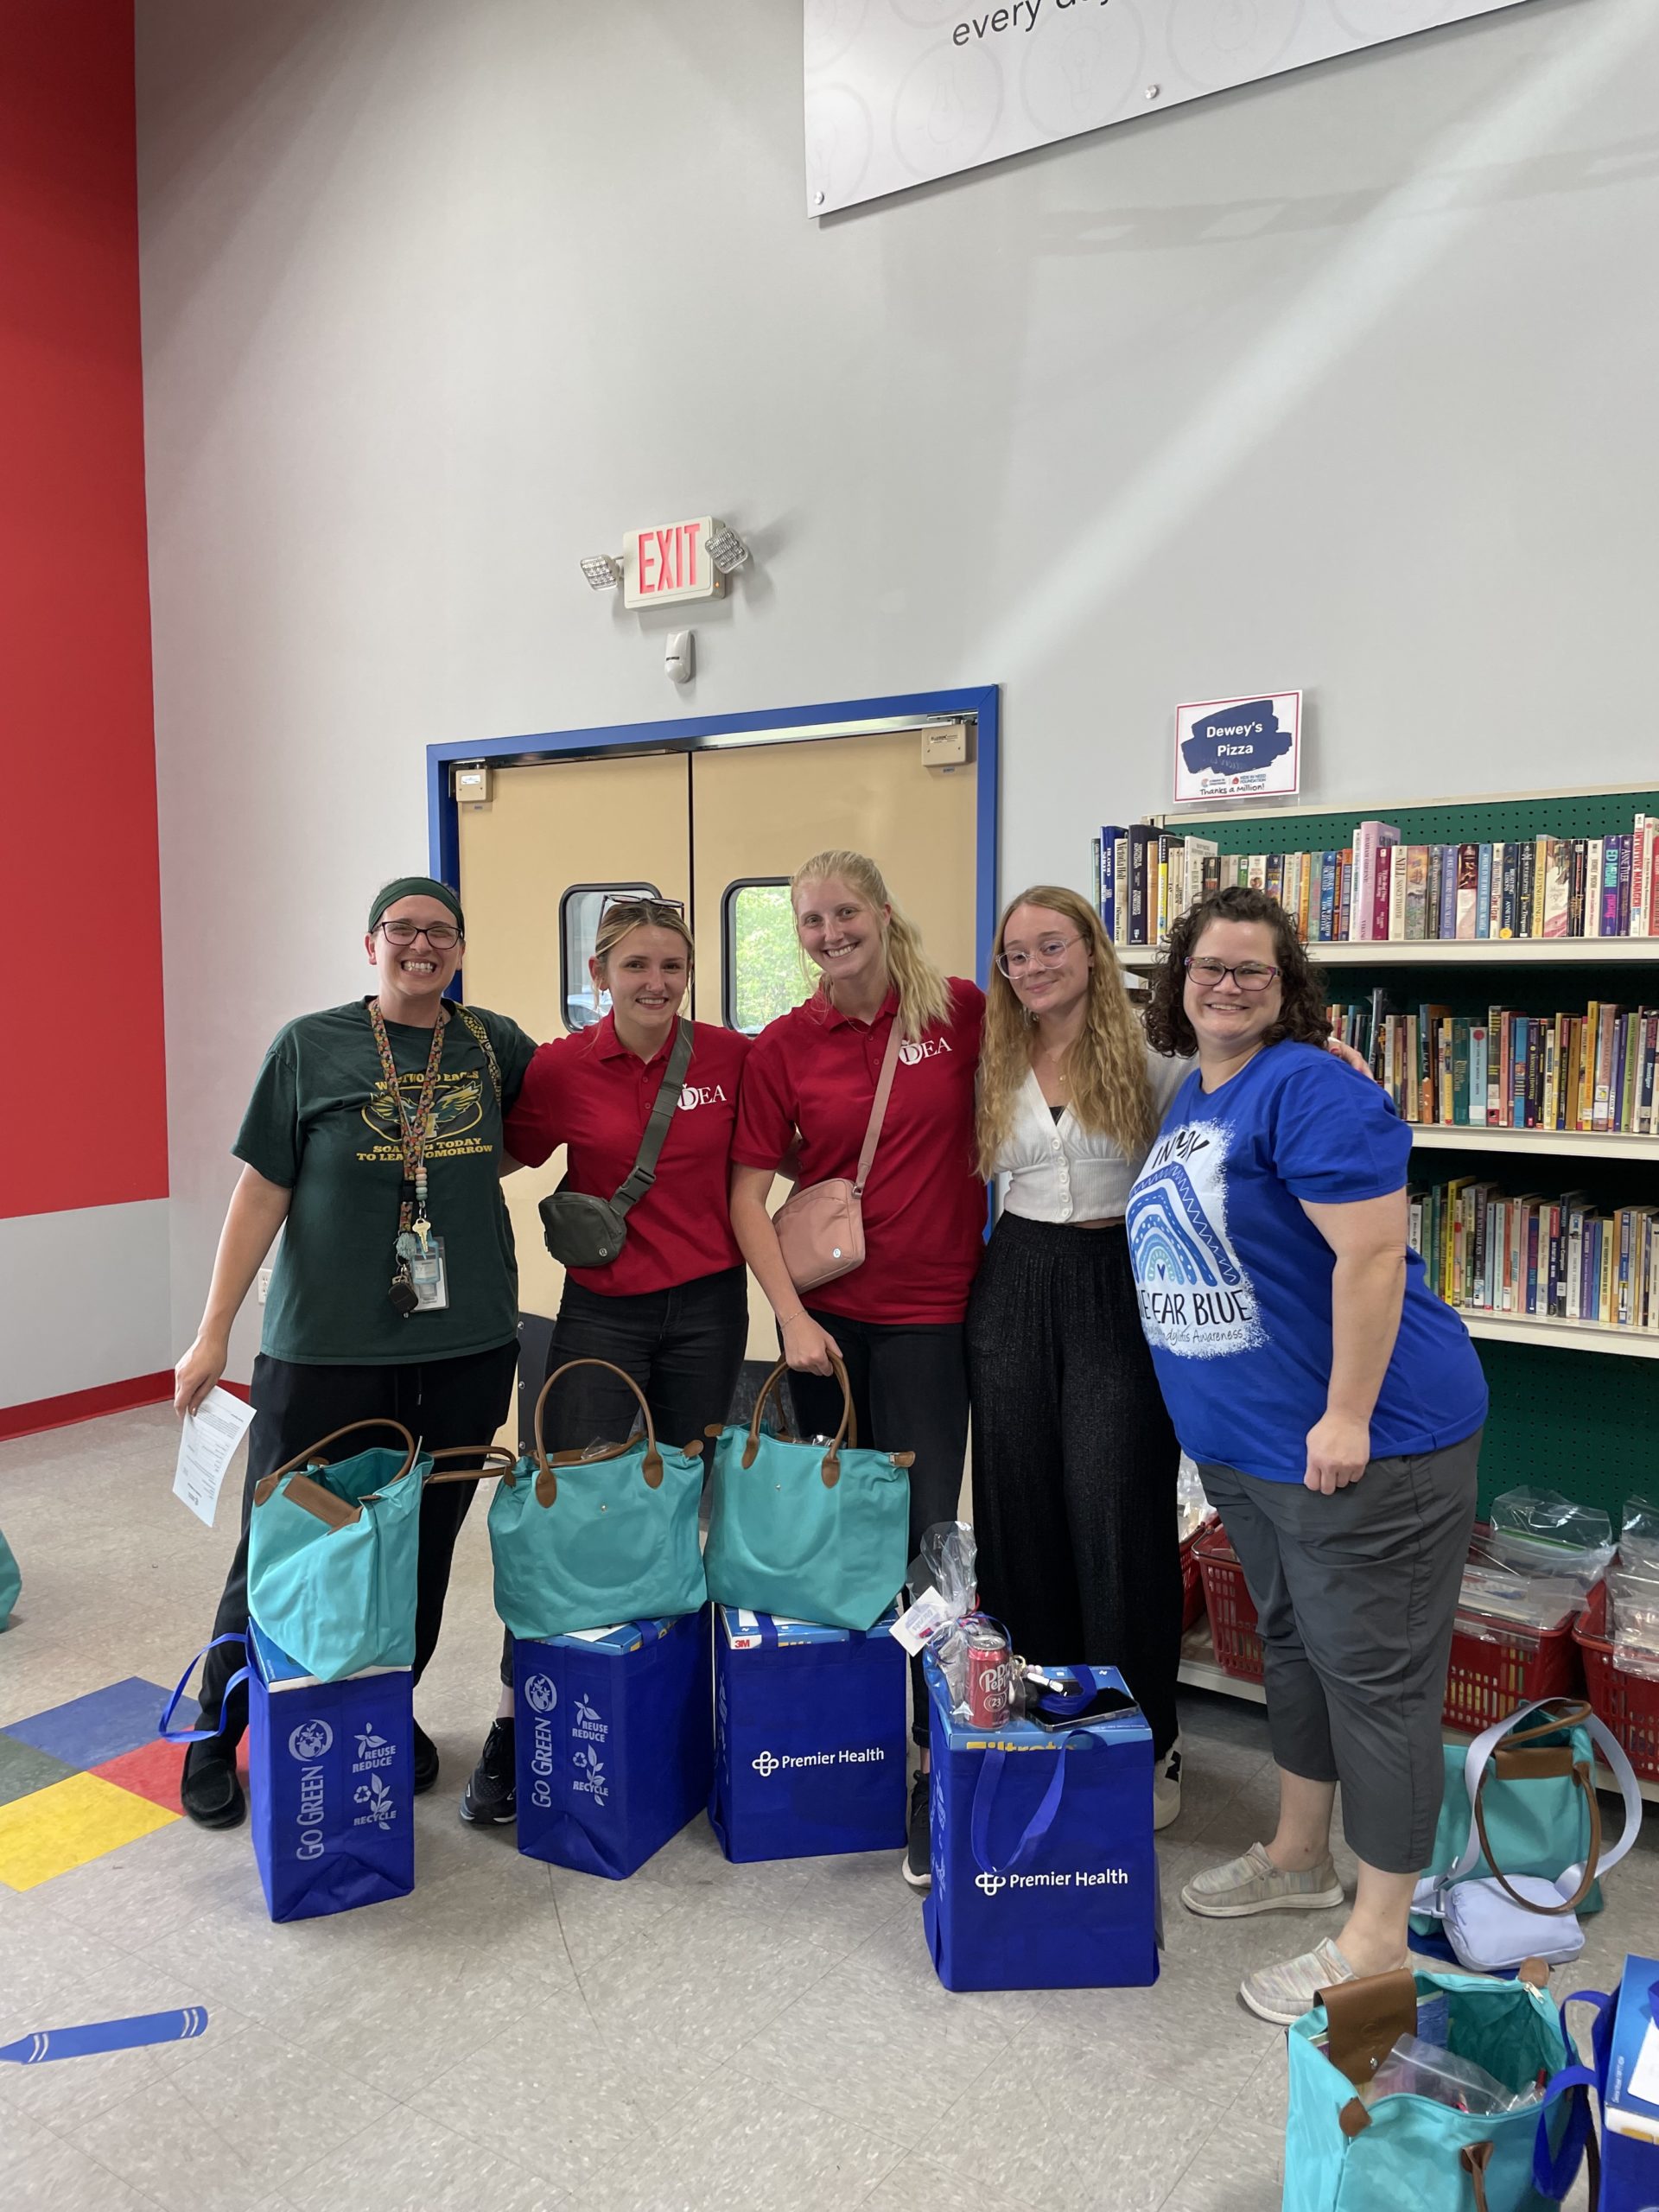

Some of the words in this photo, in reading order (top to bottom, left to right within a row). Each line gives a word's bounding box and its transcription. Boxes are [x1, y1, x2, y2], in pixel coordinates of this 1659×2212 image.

[952, 0, 1040, 46] every
[639, 523, 700, 594] EXIT
[1206, 721, 1263, 738] Dewey's
[1217, 744, 1254, 757] Pizza
[1236, 783, 1265, 792] Million!
[1116, 842, 1127, 866] Victoria
[1605, 849, 1618, 861] ED
[1621, 849, 1630, 865] ANNE
[1633, 831, 1643, 870] INTUITIVE
[1116, 867, 1126, 880] Holt
[1395, 857, 1406, 878] NELL
[1620, 866, 1630, 882] TYLER
[1631, 871, 1643, 907] MANAGER
[357, 1153, 376, 1161] TO
[378, 1153, 404, 1161] LEA
[424, 1145, 493, 1159] OMORROW
[372, 1144, 434, 1154] SOAG
[436, 1137, 481, 1149] TODAY
[1152, 1137, 1176, 1170] IN
[1192, 1289, 1252, 1325] BLUE
[1192, 1328, 1244, 1344] Awareness
[734, 1639, 751, 1649] 3M
[991, 1698, 1001, 1707] 23
[572, 1727, 606, 1743] REDUCE
[582, 1720, 608, 1734] REUSE
[365, 1745, 397, 1759] REUSE
[531, 1717, 553, 1777] GREEN
[352, 1756, 392, 1773] REDUCE
[782, 1751, 836, 1769] Premier
[838, 1747, 885, 1764] Health
[296, 1765, 324, 1826] GREEN
[531, 1779, 552, 1808] GO
[572, 1780, 609, 1796] RECYCLE
[353, 1809, 397, 1826] RECYCLE
[296, 1829, 324, 1860] GO
[1009, 1870, 1071, 1889] Premier
[1075, 1868, 1128, 1887] Health
